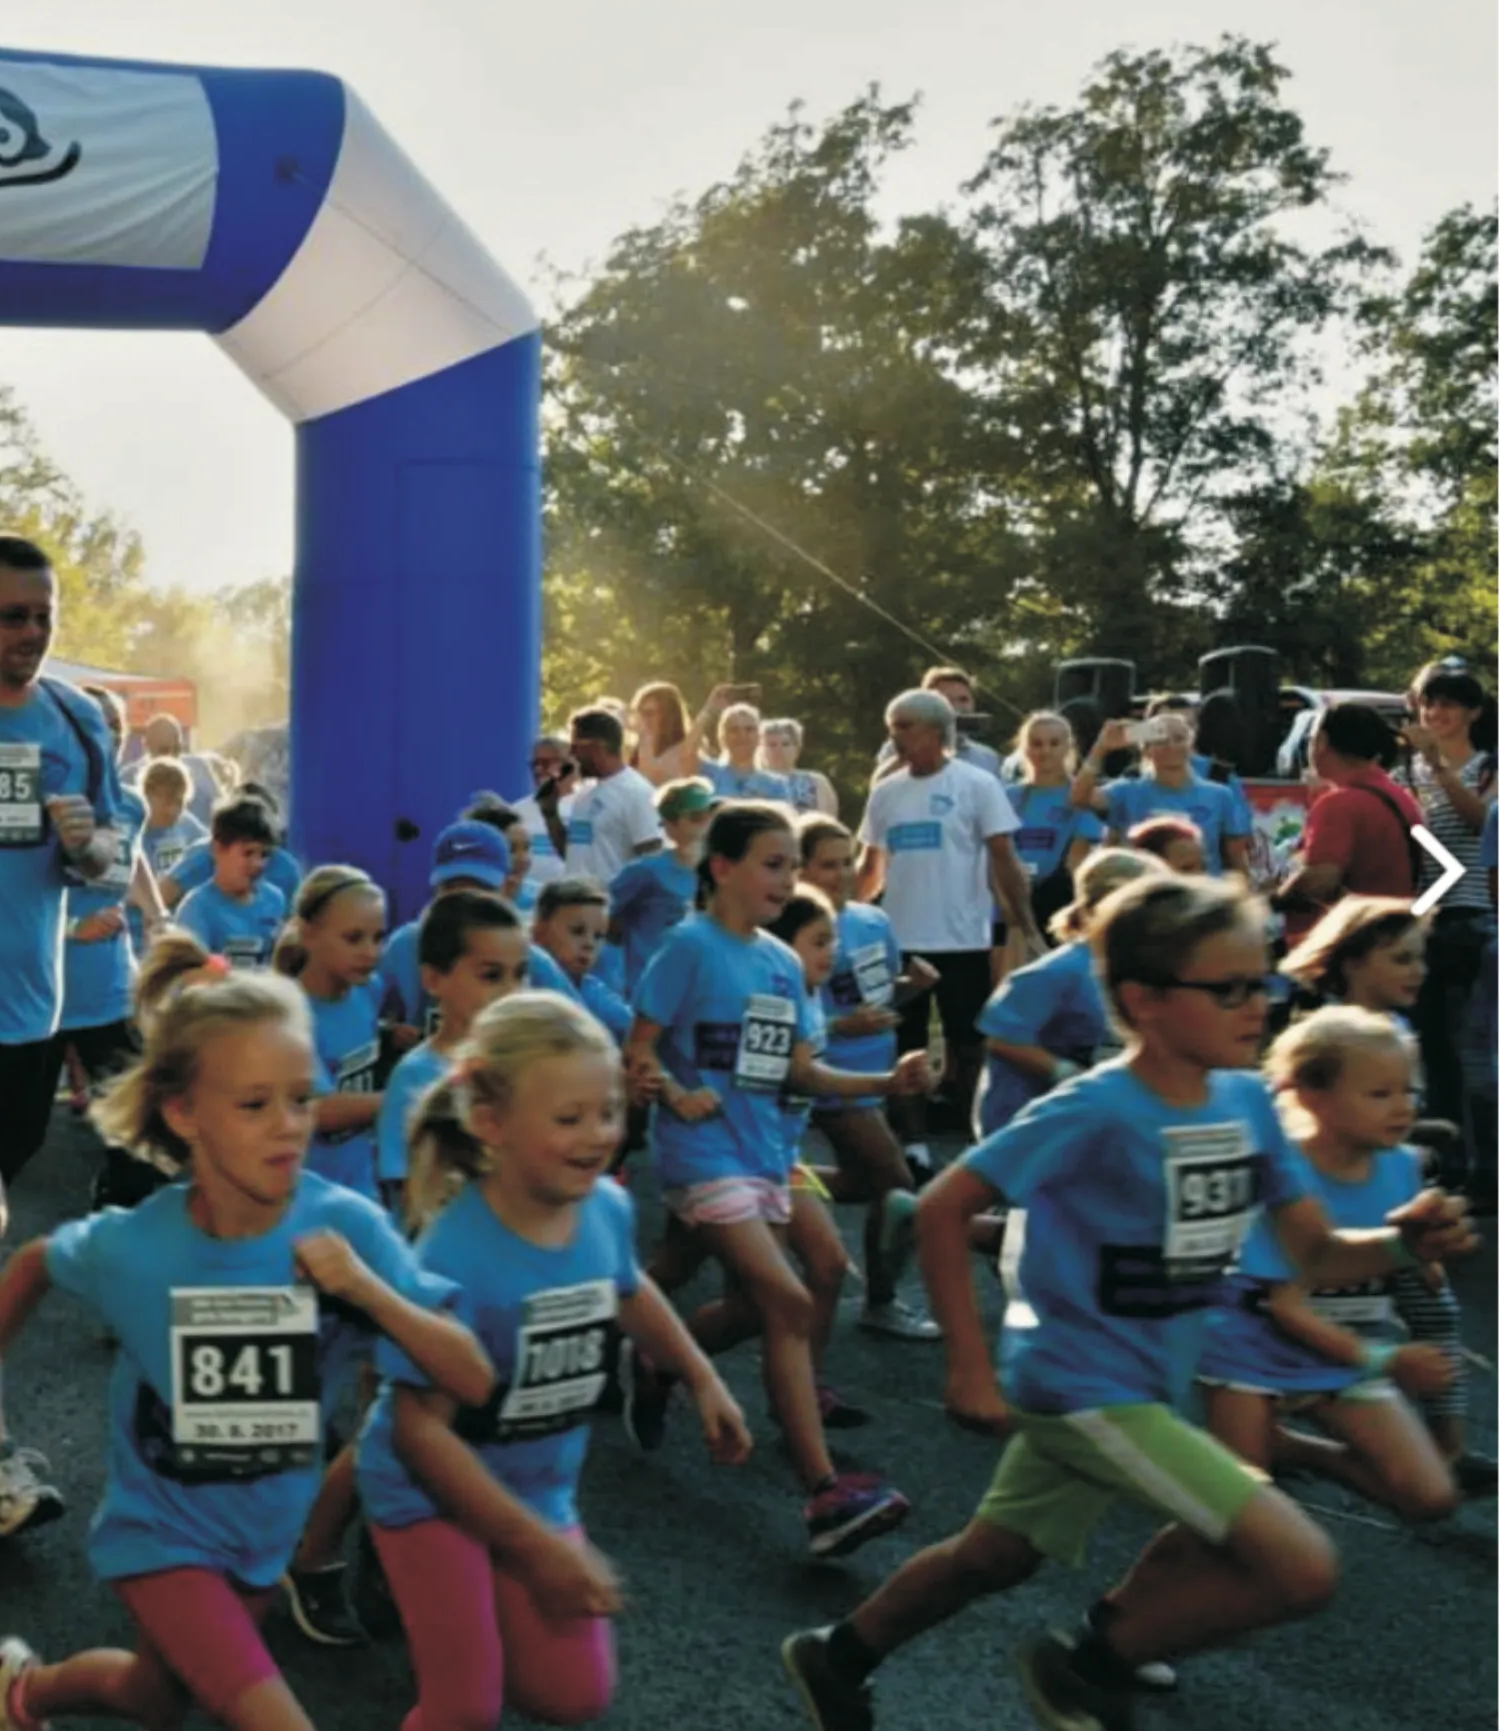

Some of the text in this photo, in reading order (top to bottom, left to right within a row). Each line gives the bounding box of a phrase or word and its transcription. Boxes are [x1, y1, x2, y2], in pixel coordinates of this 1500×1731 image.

[746, 1021, 791, 1055] 923
[191, 1344, 294, 1397] 841
[252, 1422, 299, 1438] 2017
